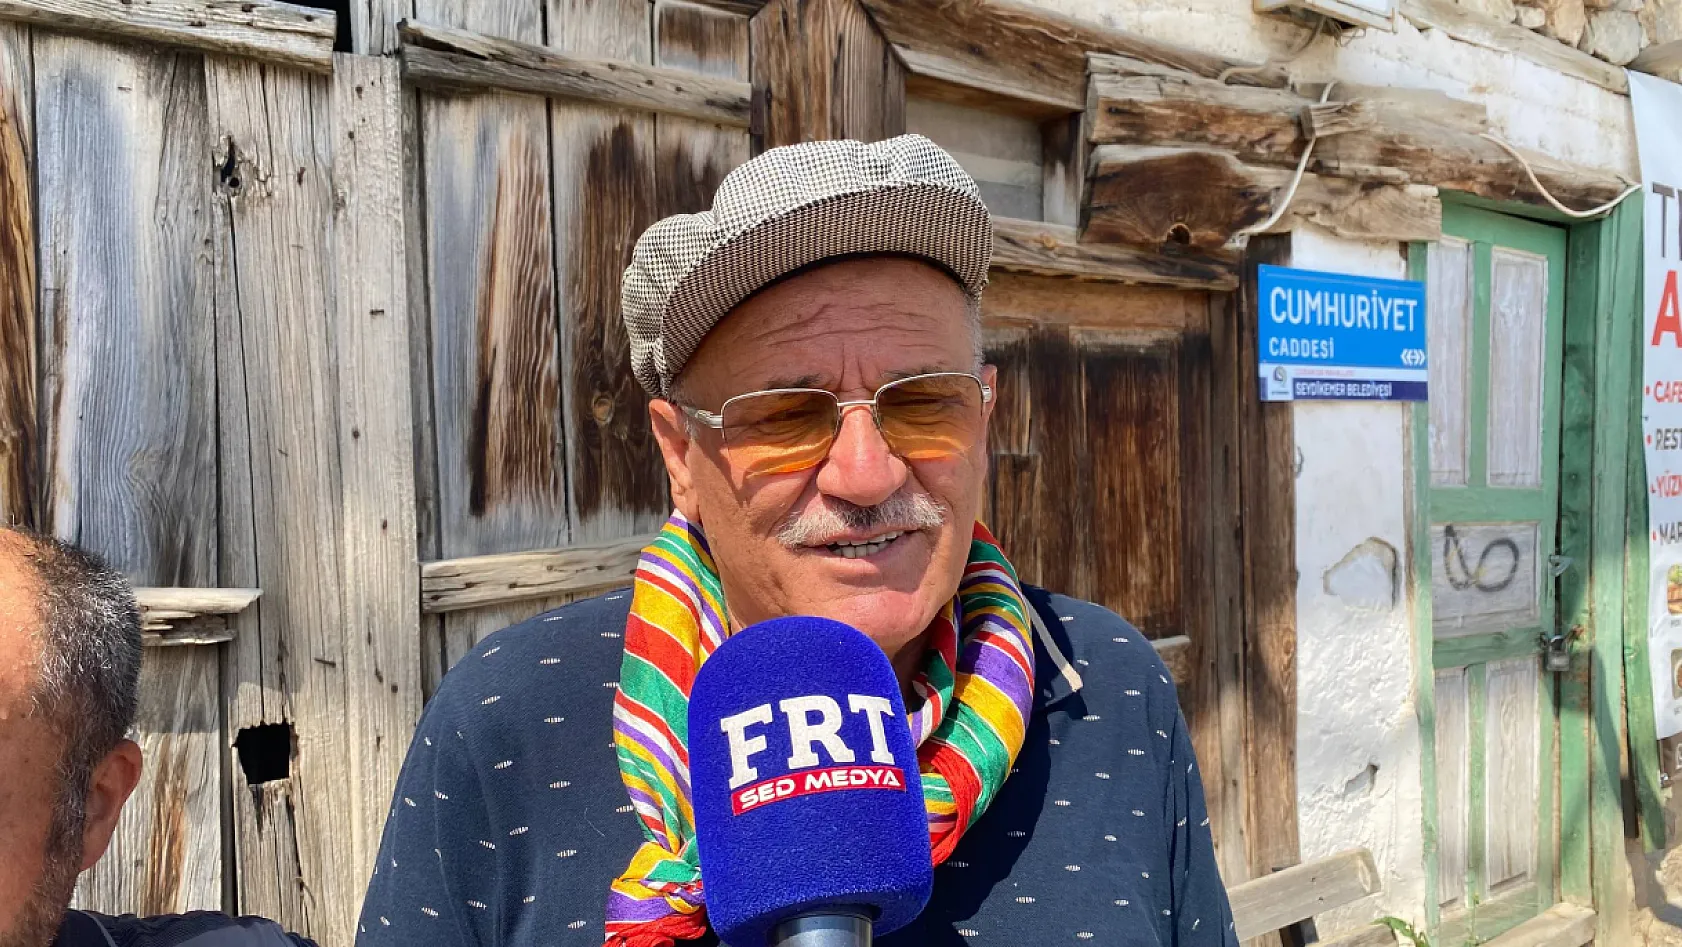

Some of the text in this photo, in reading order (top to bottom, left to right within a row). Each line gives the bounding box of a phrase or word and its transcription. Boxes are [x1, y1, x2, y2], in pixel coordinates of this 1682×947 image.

[1652, 181, 1682, 261] T
[1270, 286, 1417, 332] CUMHURİYET
[1268, 336, 1334, 359] CADDESİ
[1295, 380, 1392, 398] SEYDİKEMER BELEDİYESİ
[720, 694, 895, 790] FRT
[739, 768, 901, 810] SED MEDYA
